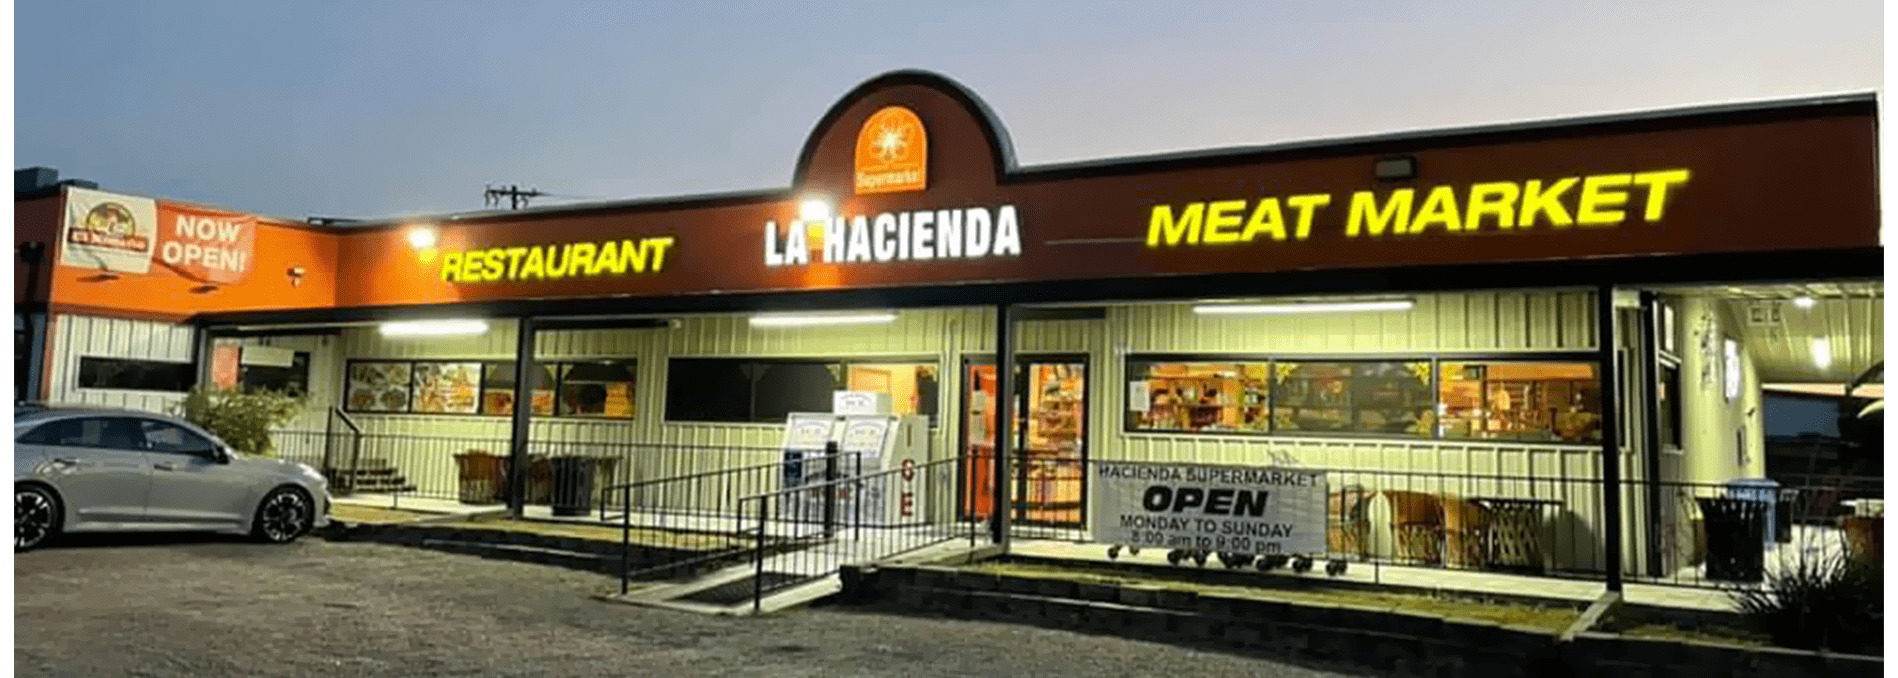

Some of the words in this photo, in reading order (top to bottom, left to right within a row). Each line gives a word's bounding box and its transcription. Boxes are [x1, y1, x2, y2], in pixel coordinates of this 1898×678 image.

[1147, 194, 1331, 247] MEAT
[1346, 169, 1691, 237] MARKET
[175, 214, 241, 242] NOW
[764, 219, 808, 266] LA
[822, 205, 1021, 264] HACIENDA
[162, 241, 247, 273] OPEN!
[441, 237, 673, 282] RESTAURANT
[1099, 465, 1181, 482] HACIENDA
[1186, 467, 1318, 487] SUPERMARKET
[1142, 485, 1269, 517] OPEN
[1120, 514, 1190, 532] MONDAY
[1194, 519, 1217, 534] TO
[1222, 520, 1294, 539] SUNDAY
[1167, 534, 1192, 547] am
[1196, 533, 1212, 548] to
[1255, 540, 1282, 554] pm
